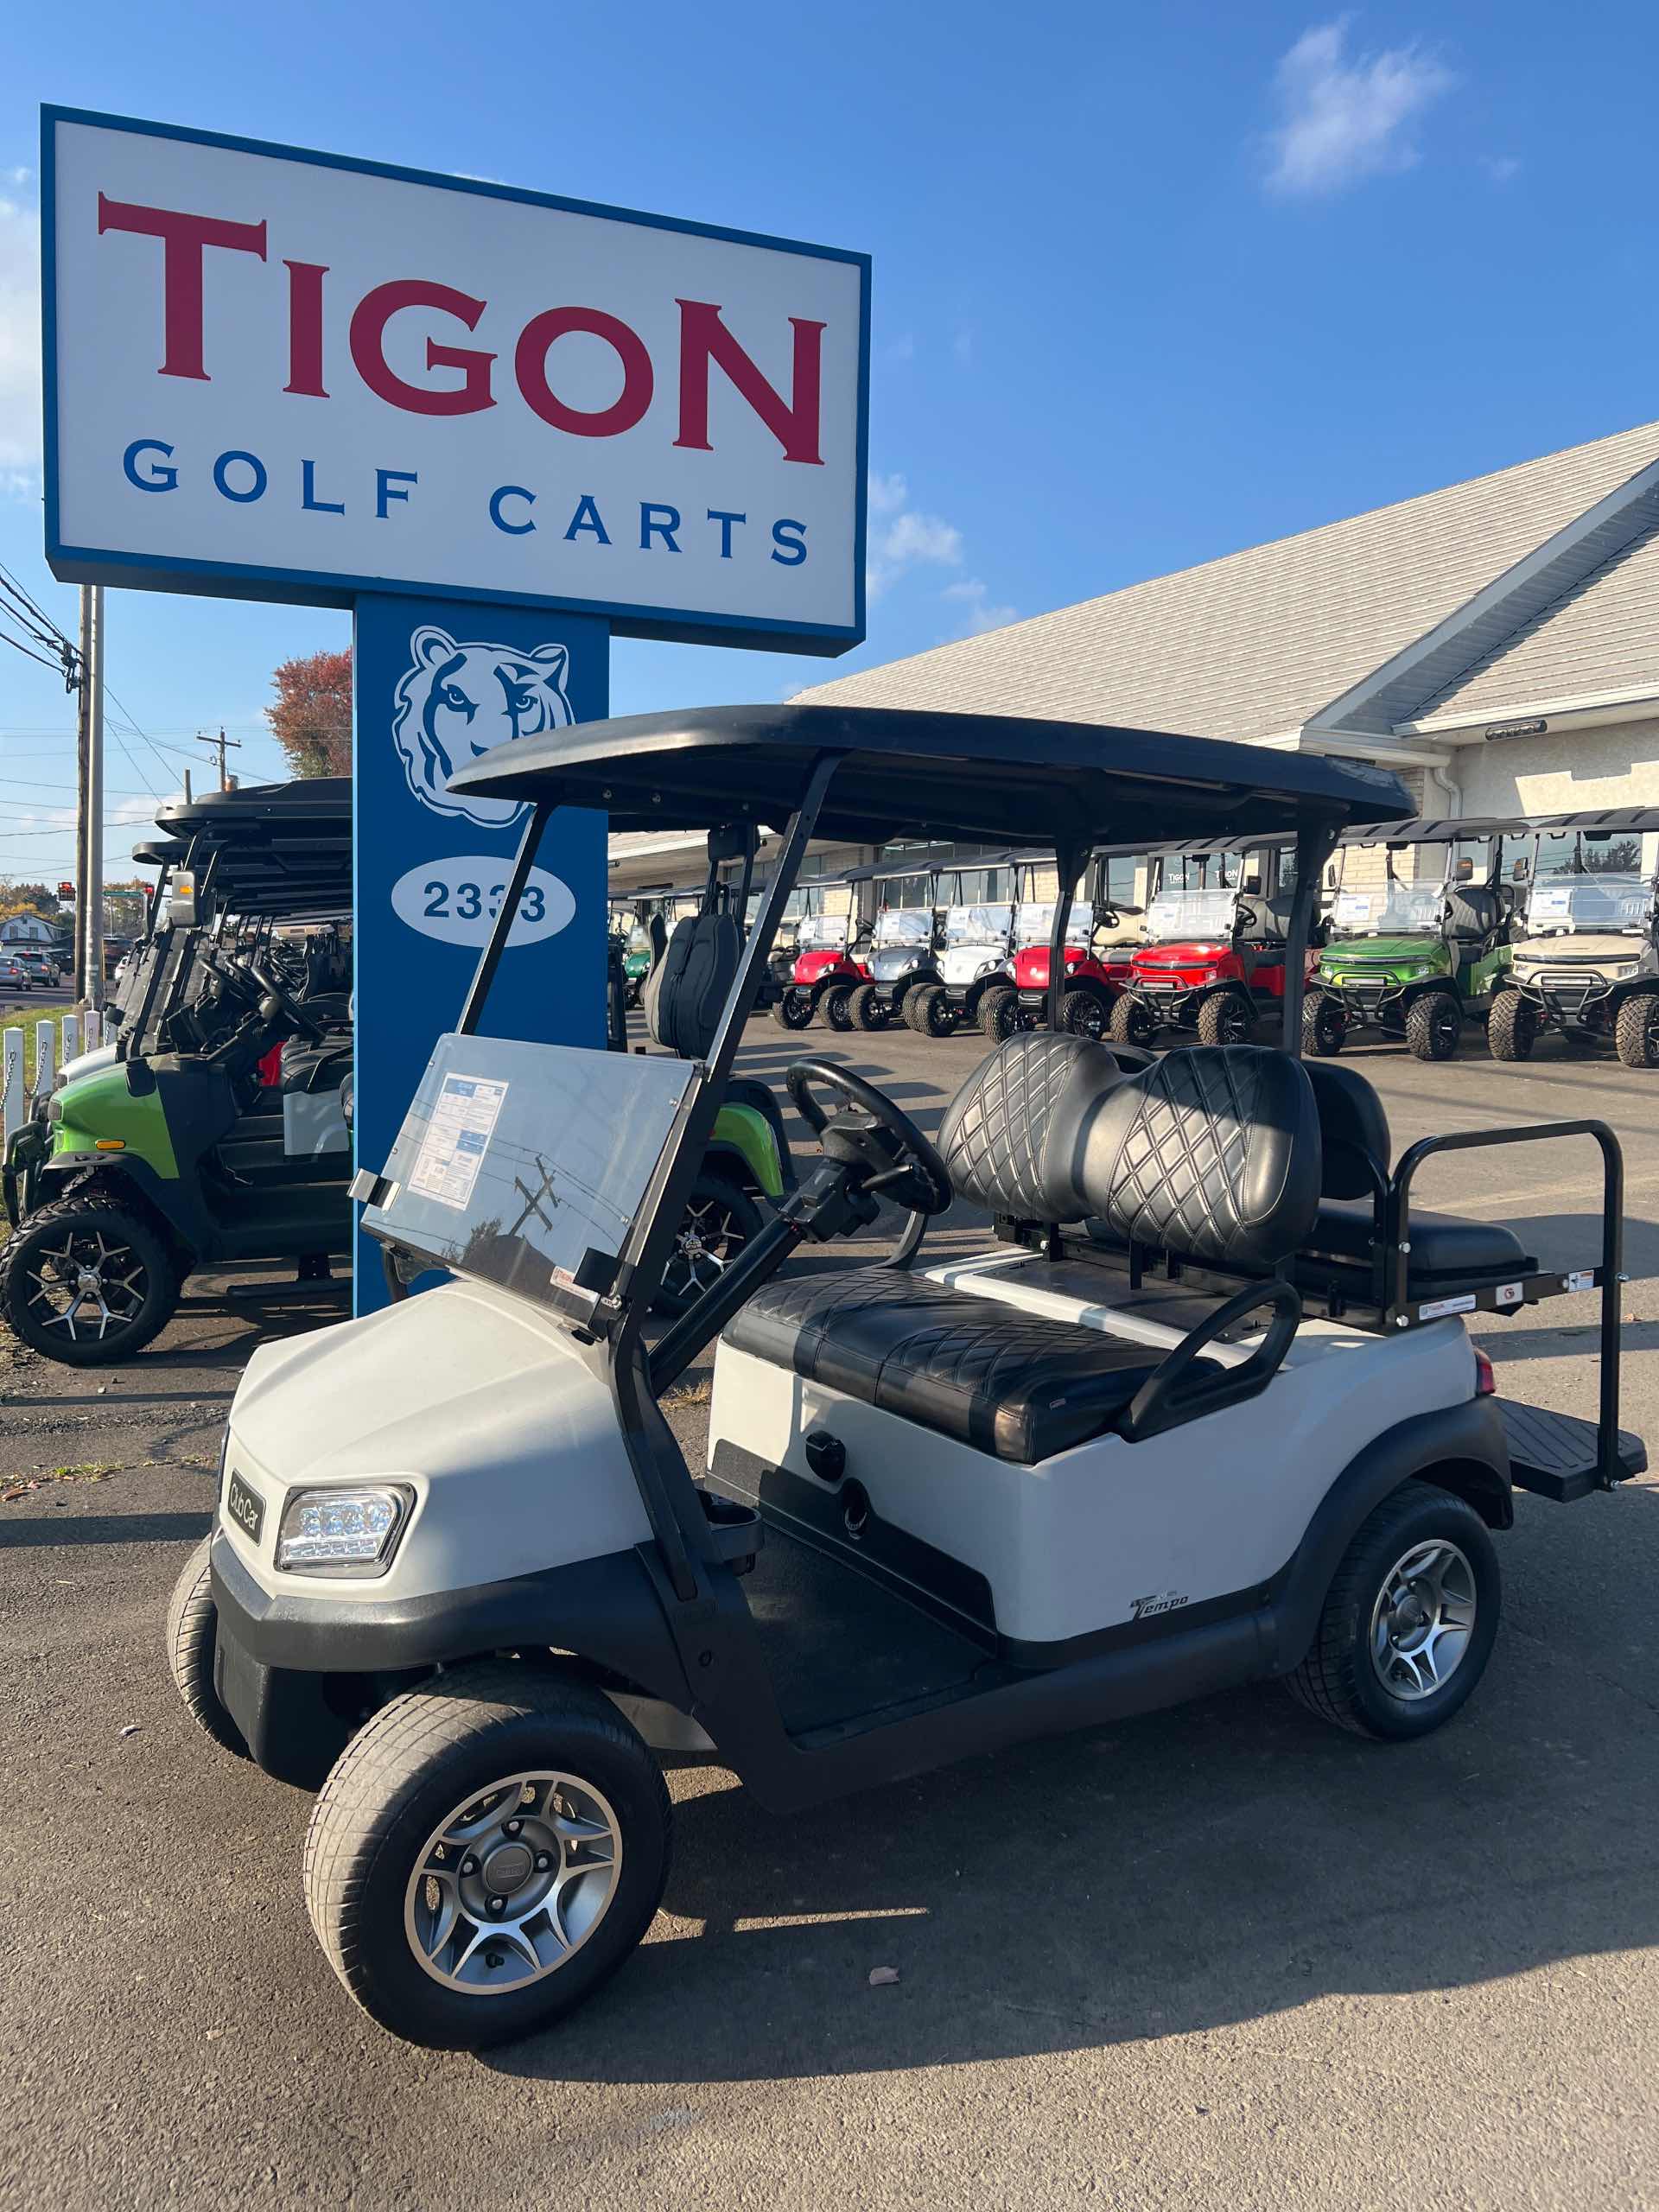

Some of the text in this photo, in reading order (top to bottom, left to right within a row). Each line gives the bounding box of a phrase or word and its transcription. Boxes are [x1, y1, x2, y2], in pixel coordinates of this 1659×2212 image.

[99, 191, 827, 465] TIGON
[123, 438, 808, 567] GOLF CARTS
[244, 1498, 258, 1531] Car
[1129, 1595, 1189, 1618] Tempo
